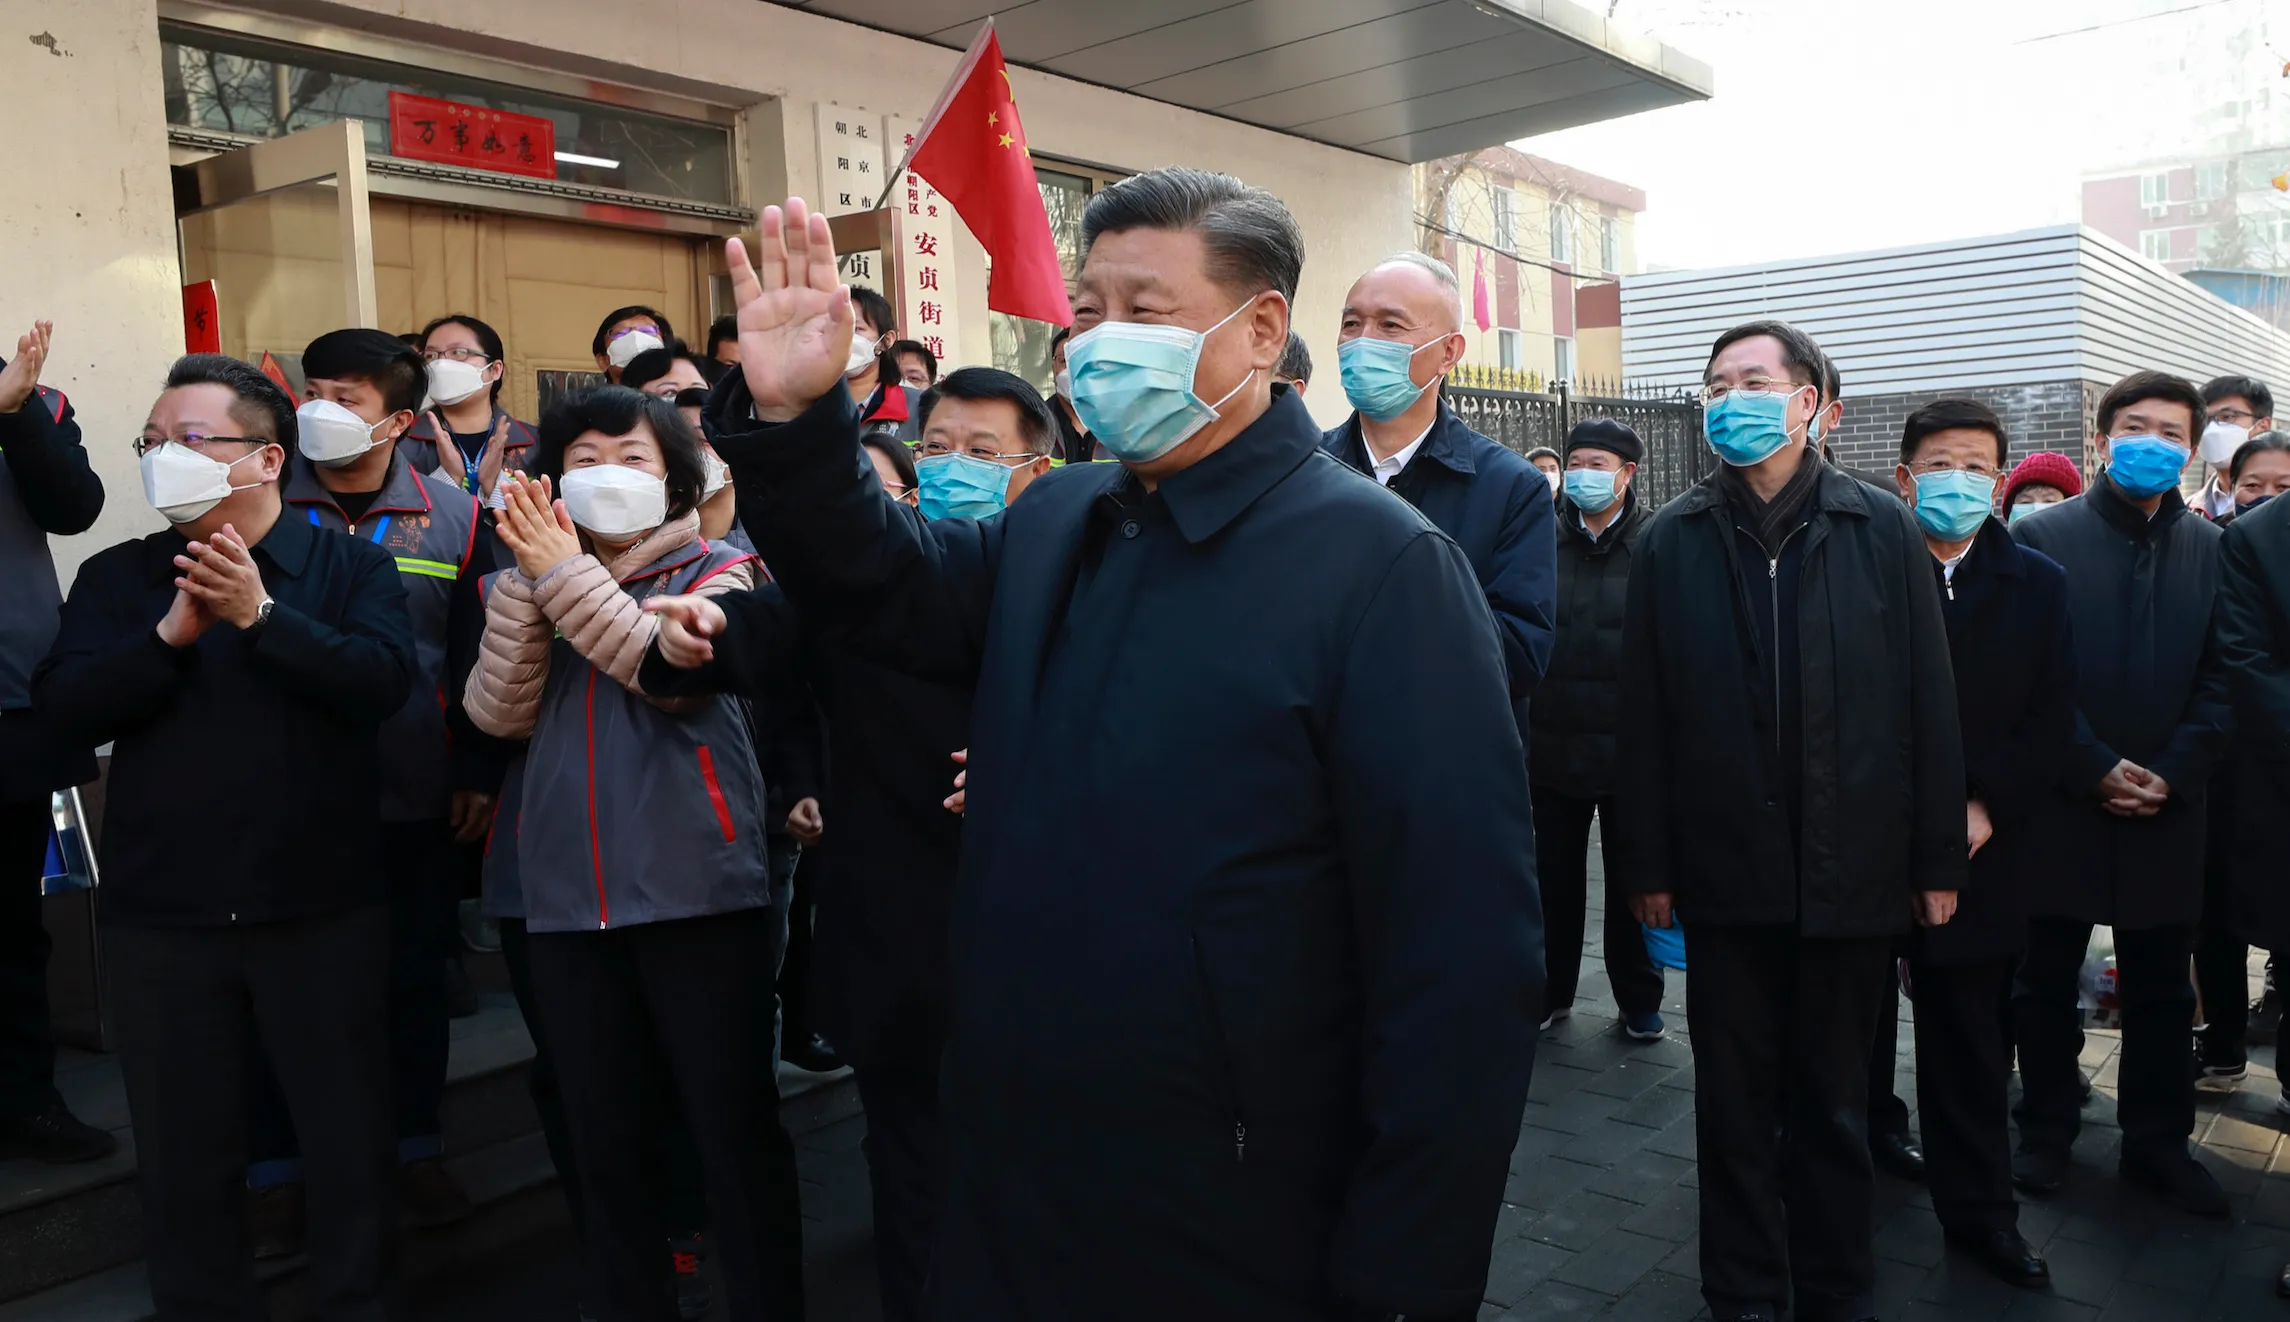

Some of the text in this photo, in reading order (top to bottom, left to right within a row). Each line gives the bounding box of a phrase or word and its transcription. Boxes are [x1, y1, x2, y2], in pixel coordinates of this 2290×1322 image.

[413, 119, 536, 163] 万事如意
[835, 121, 852, 206] 朝阳区
[856, 125, 871, 208] 北京市
[904, 133, 919, 215] 北朝阳区
[914, 232, 946, 381] 安贞街道
